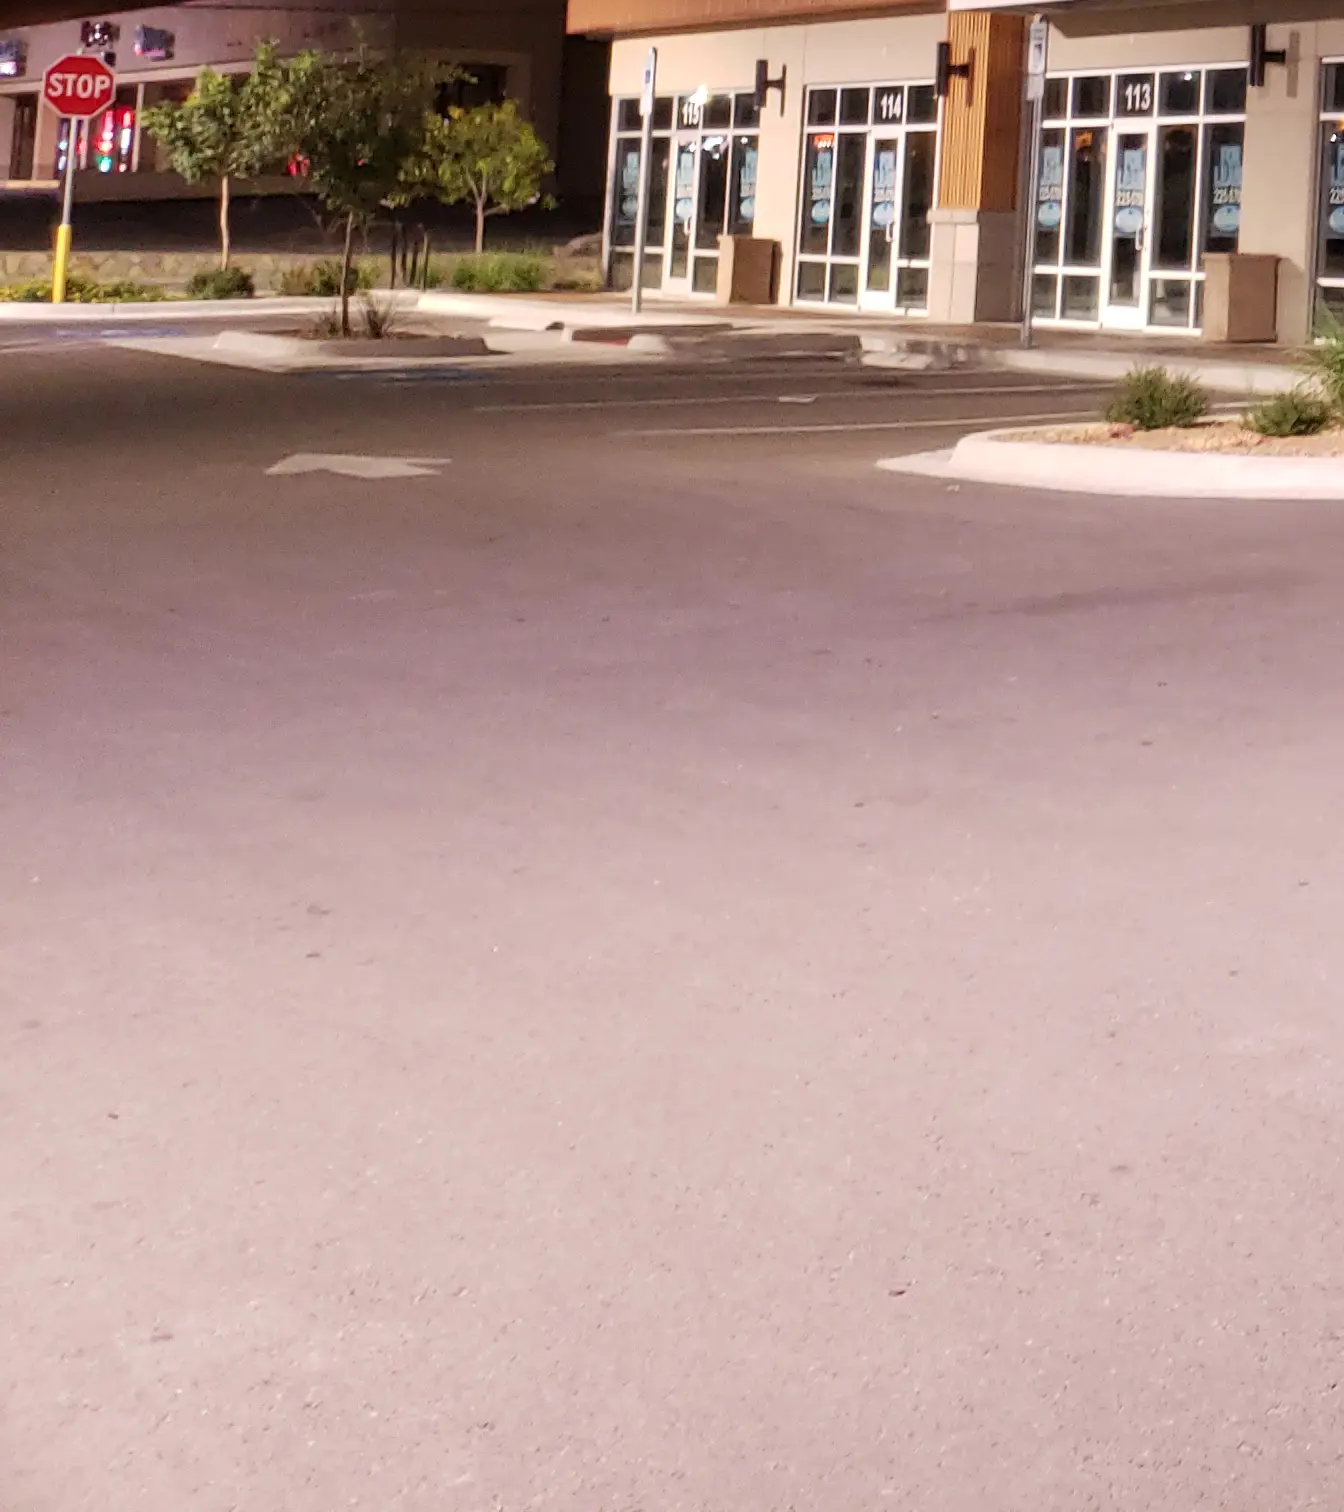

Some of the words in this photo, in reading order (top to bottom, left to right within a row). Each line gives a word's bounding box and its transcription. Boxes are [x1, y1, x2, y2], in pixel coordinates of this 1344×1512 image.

[48, 72, 110, 99] STOP
[1125, 83, 1151, 111] 113
[880, 92, 901, 120] 114
